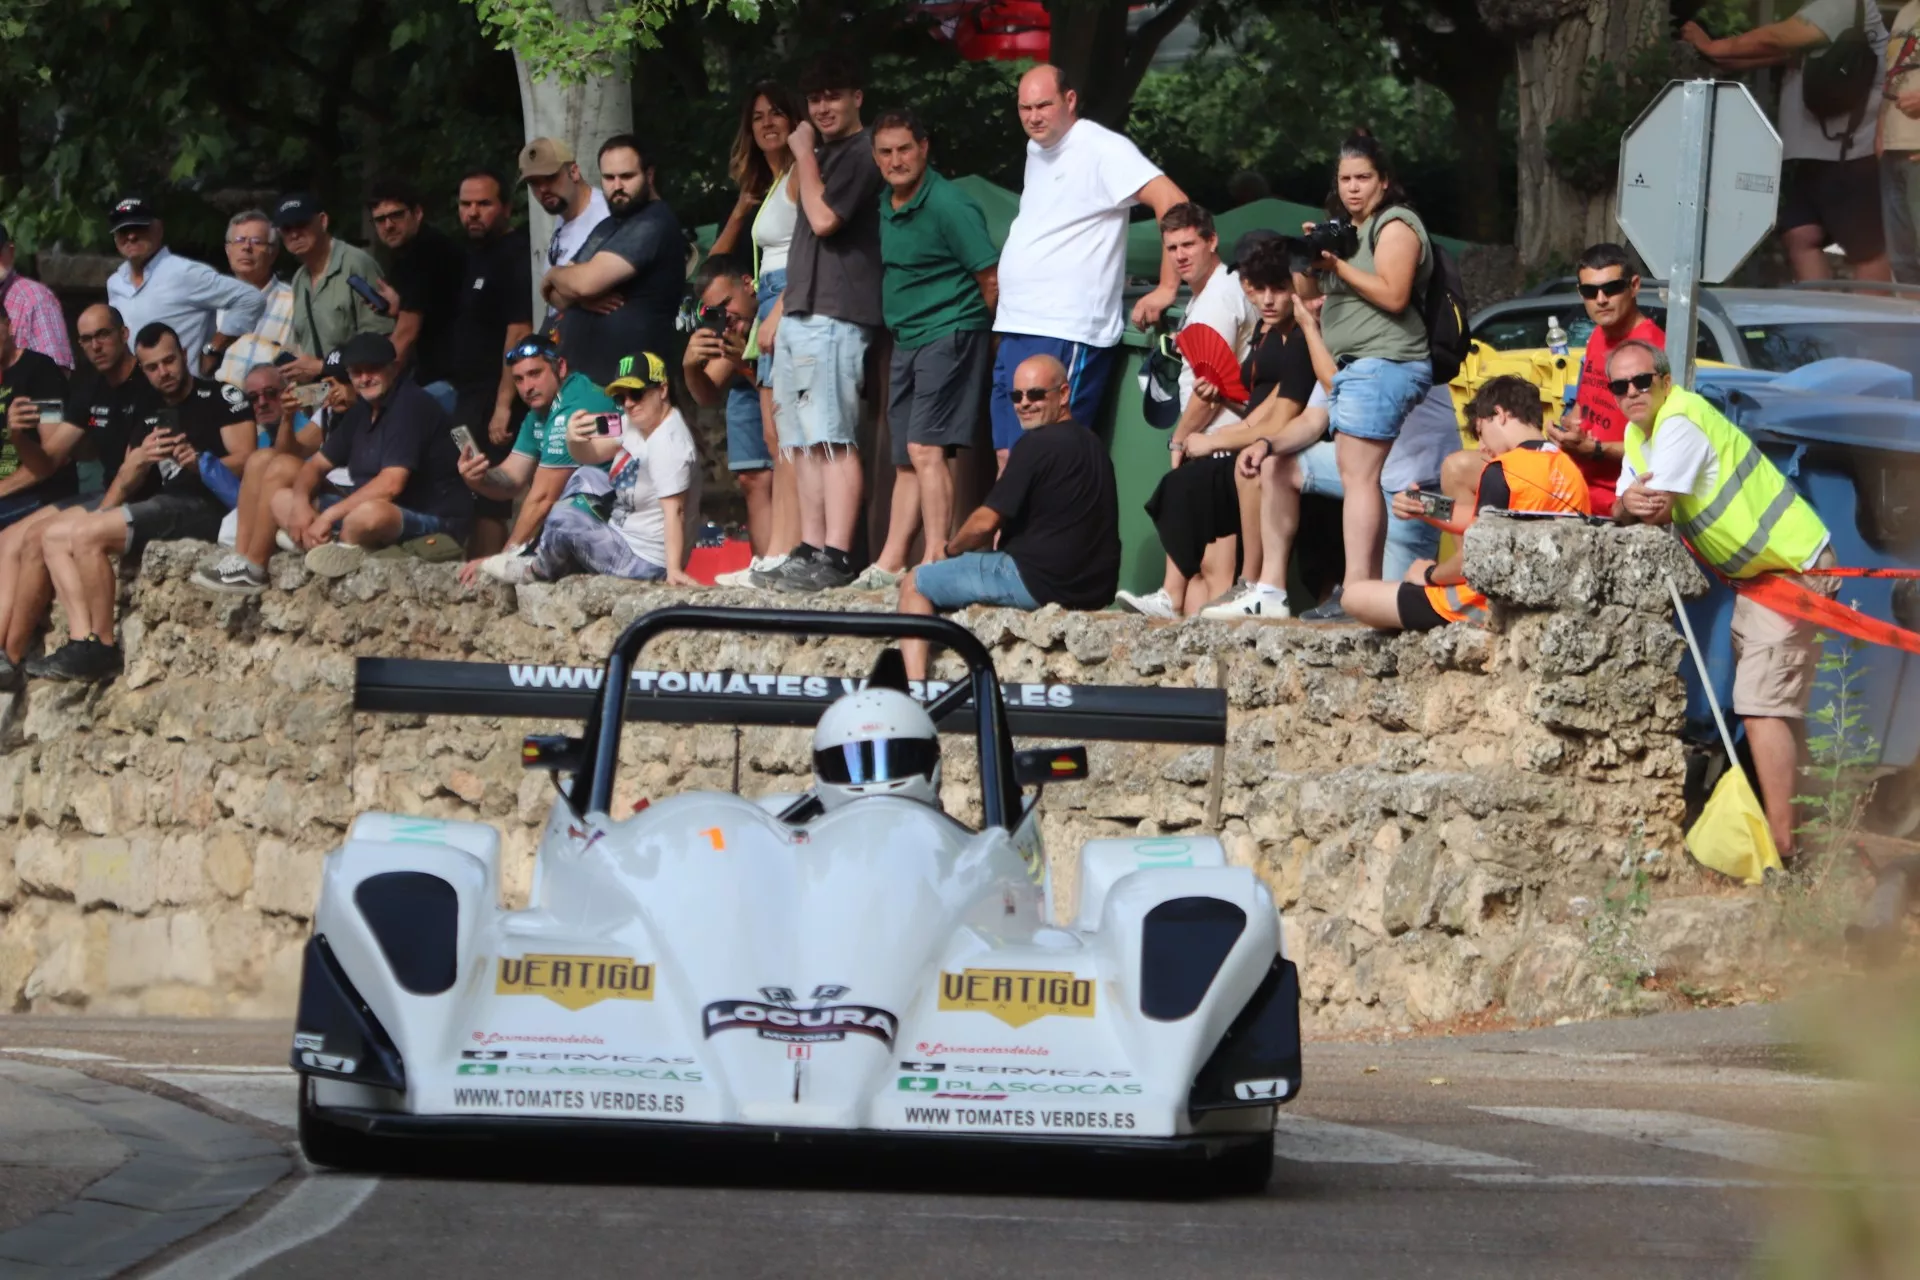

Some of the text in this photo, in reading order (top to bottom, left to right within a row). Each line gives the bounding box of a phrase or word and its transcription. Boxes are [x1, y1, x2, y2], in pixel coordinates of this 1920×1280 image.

[502, 959, 651, 991] VERTIGO
[944, 973, 1090, 1007] VERTIGO
[707, 1004, 894, 1040] LOCURA
[763, 1031, 840, 1041] MOTORA
[591, 1091, 685, 1113] VERDES.ES
[957, 1108, 1036, 1126] TOMATES
[1041, 1110, 1136, 1129] VERDES.ES
